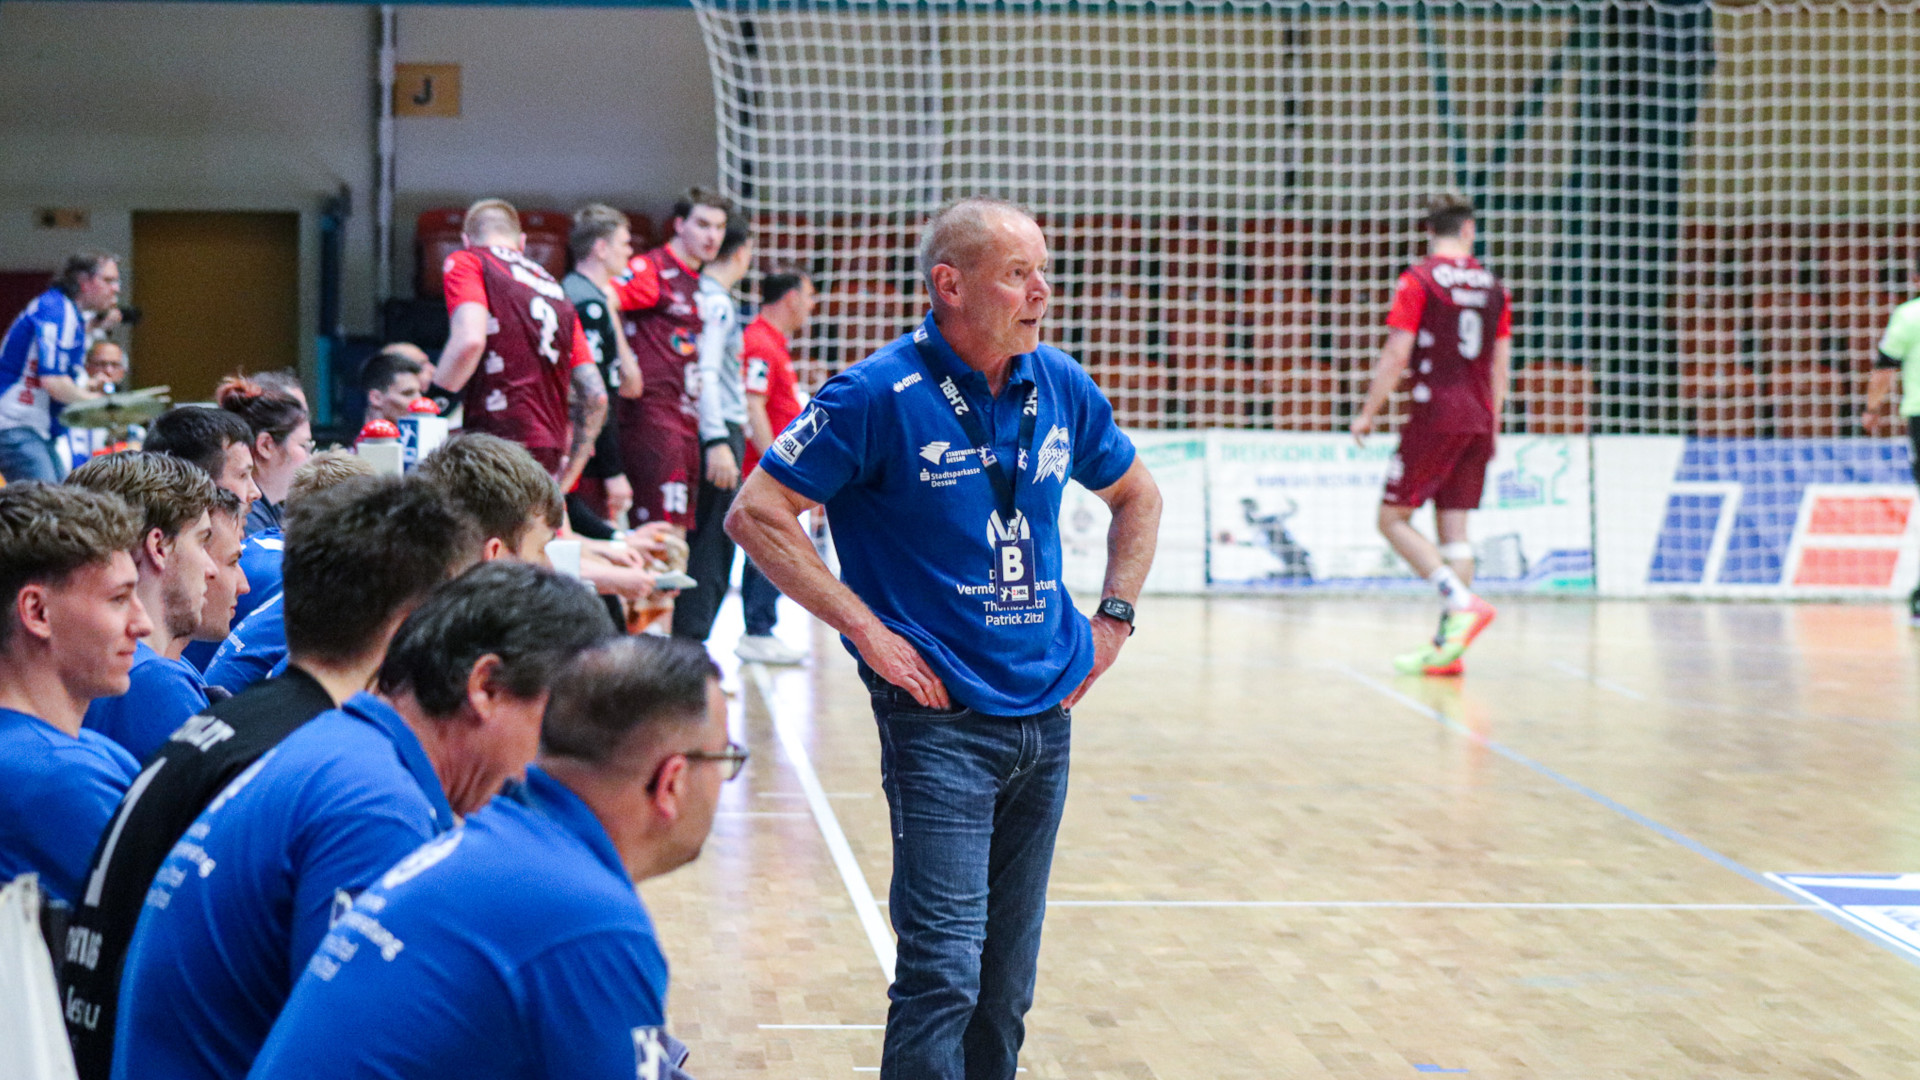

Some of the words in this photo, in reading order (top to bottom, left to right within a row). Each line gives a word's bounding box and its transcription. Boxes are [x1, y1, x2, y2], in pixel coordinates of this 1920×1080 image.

[412, 76, 432, 106] J
[530, 296, 559, 364] 2
[1458, 308, 1483, 360] 9
[939, 376, 969, 416] 2.HBL
[1023, 385, 1038, 416] 2.H
[945, 448, 977, 458] STADTWERK
[931, 468, 981, 480] Stadtsparkasse
[931, 479, 957, 488] Dessau
[660, 482, 688, 514] 15
[1001, 546, 1025, 582] B
[985, 613, 1022, 627] Patrick
[1024, 612, 1044, 624] Zitzl
